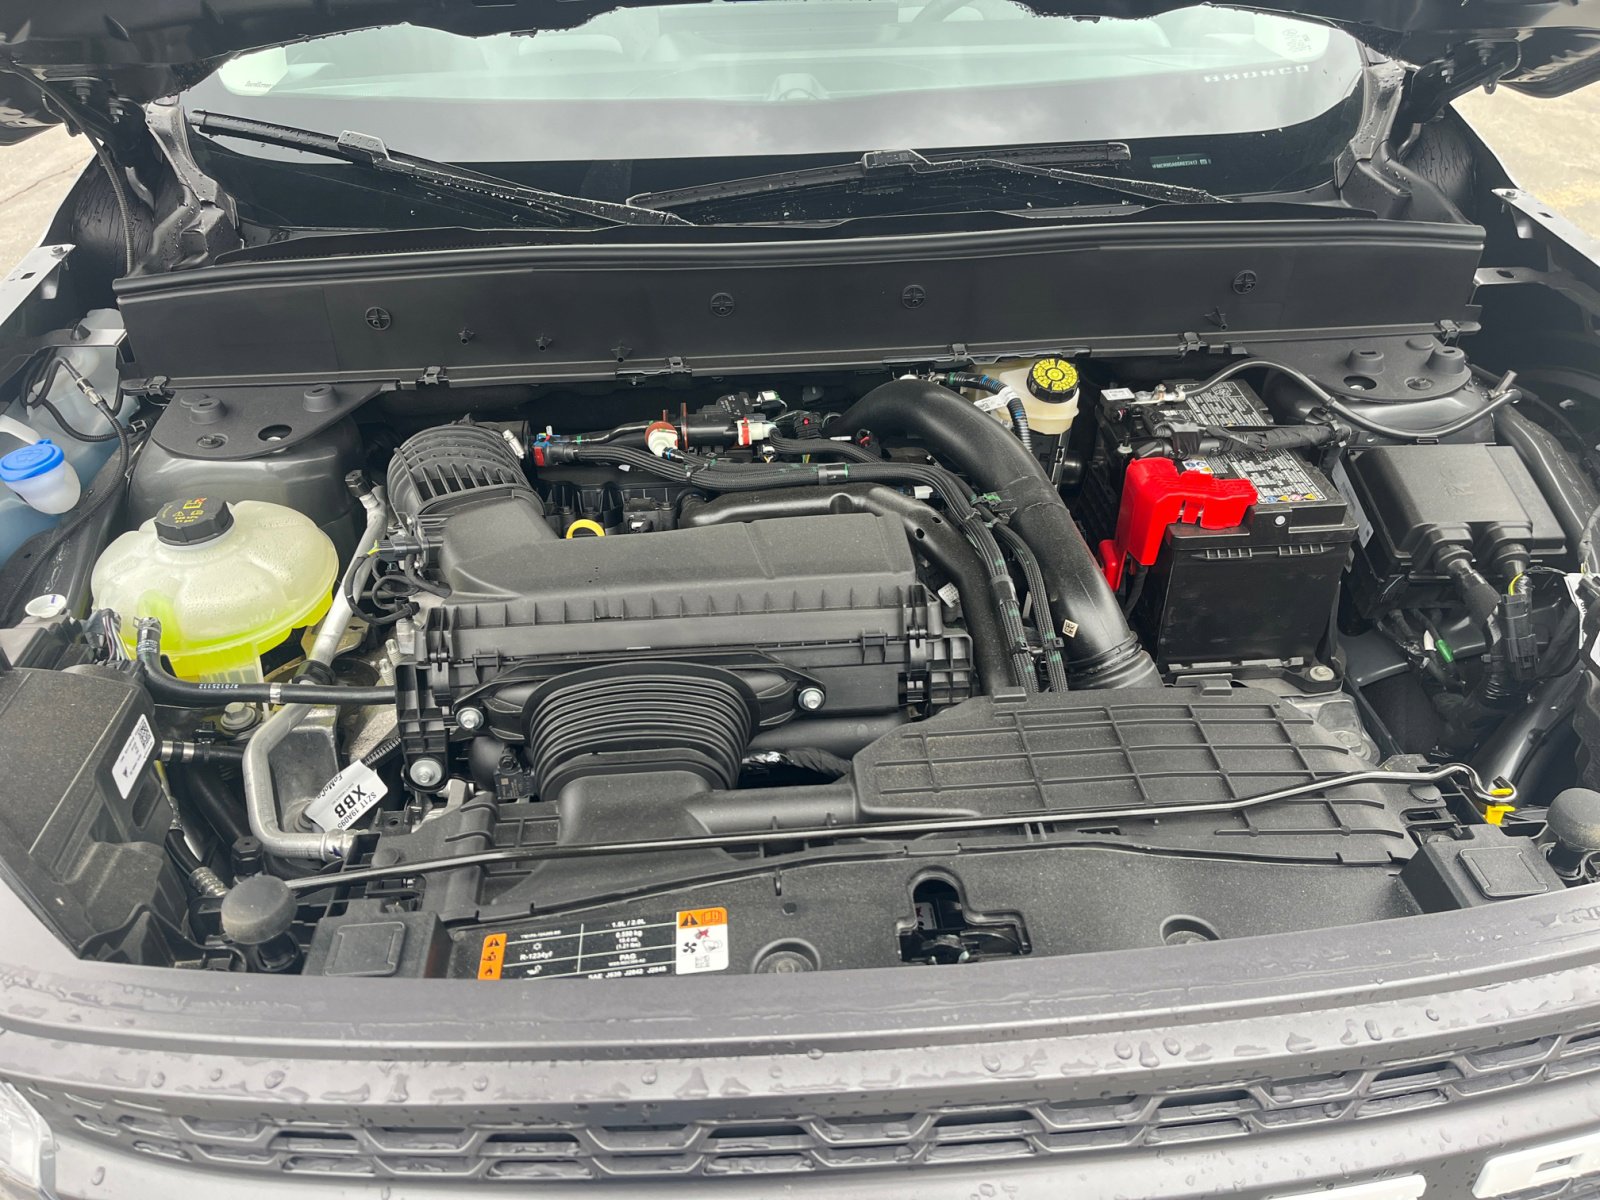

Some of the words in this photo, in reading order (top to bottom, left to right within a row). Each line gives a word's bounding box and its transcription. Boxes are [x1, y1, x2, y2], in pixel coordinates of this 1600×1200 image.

[334, 784, 367, 818] XBB
[633, 929, 643, 938] kg
[519, 951, 553, 961] R-1234yf
[619, 953, 637, 961] PAG
